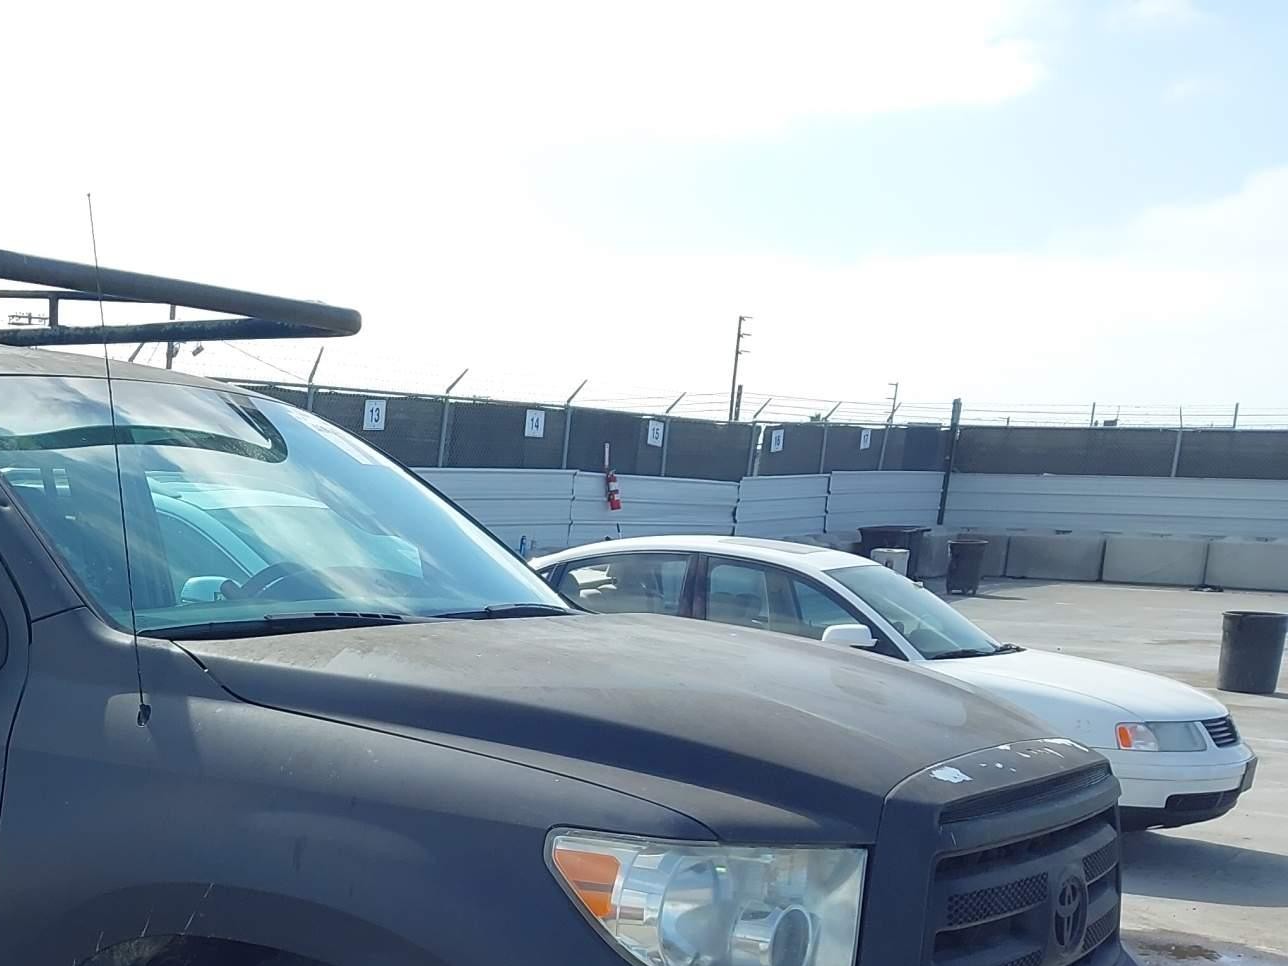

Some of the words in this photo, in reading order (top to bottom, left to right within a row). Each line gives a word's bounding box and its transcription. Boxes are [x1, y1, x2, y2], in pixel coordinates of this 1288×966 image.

[369, 407, 380, 423] 13
[530, 416, 540, 431] 14
[652, 427, 660, 440] 15
